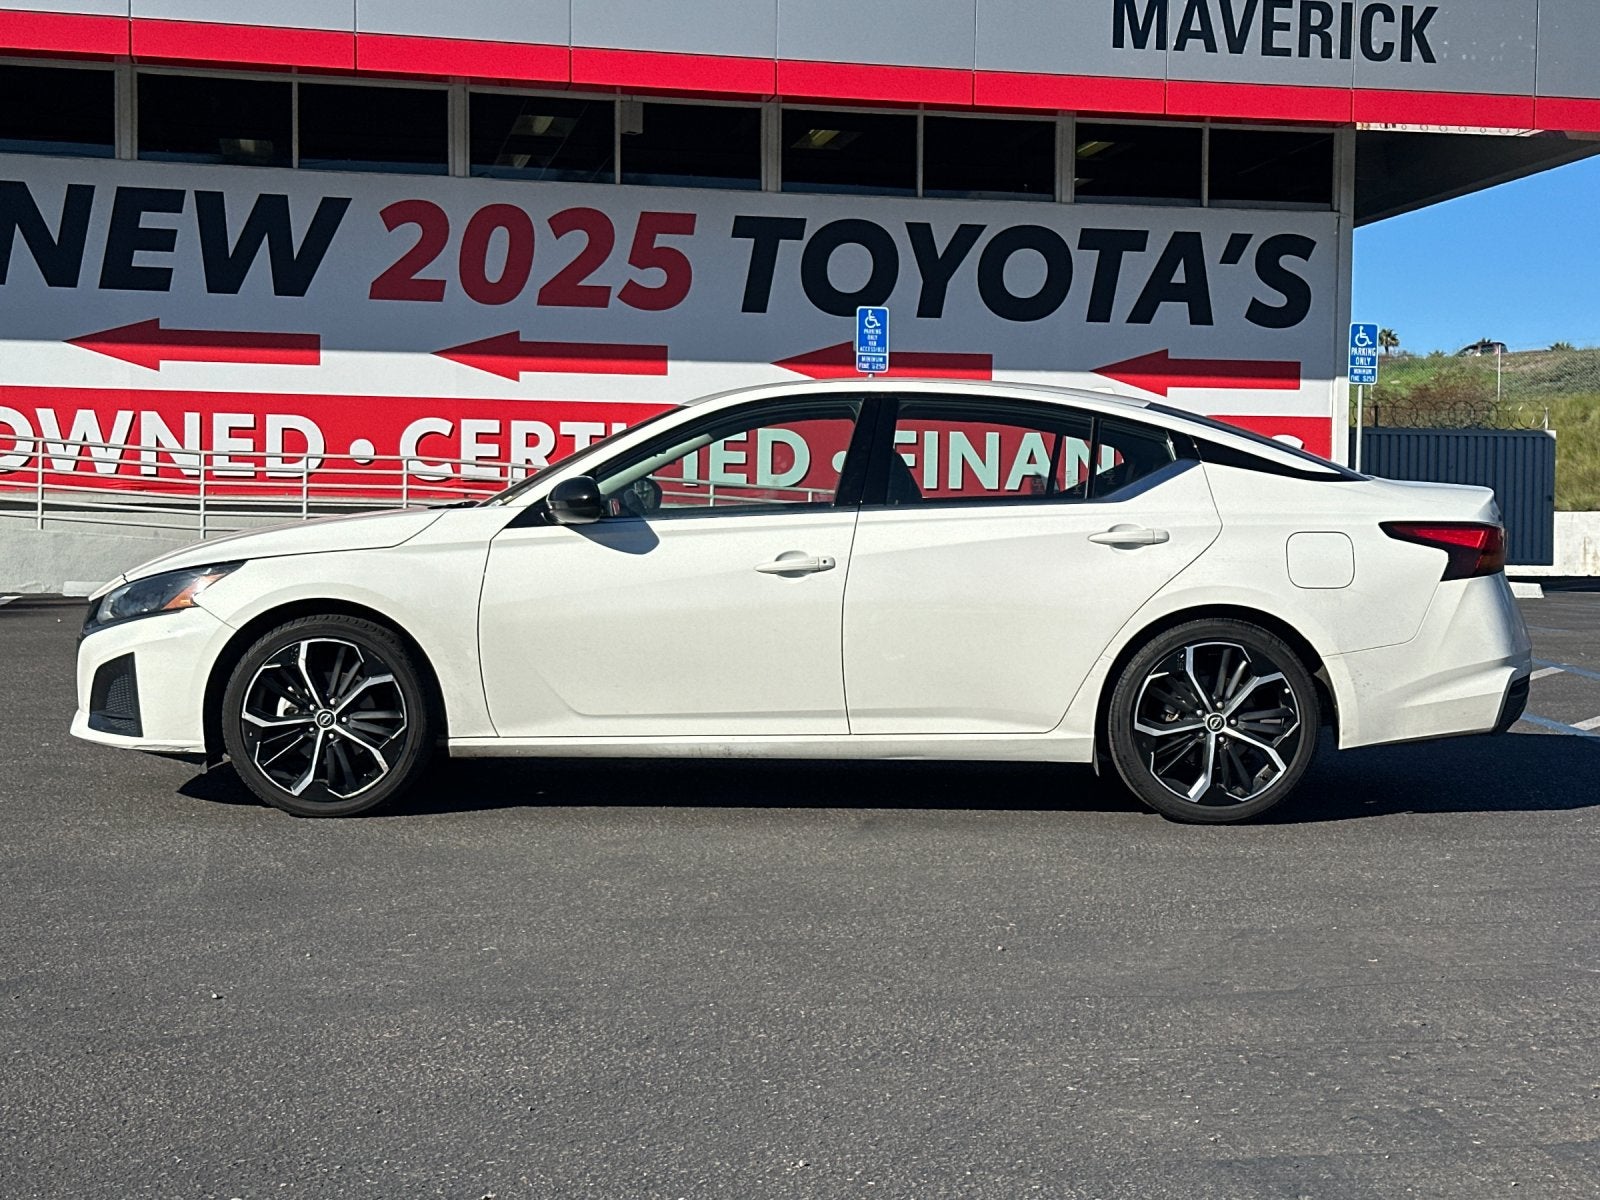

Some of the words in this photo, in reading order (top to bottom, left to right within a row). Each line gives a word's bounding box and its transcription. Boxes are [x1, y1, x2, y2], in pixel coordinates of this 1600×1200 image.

[1112, 0, 1438, 63] MAVERICK
[0, 180, 352, 297] NEW
[369, 199, 697, 311] 2025
[731, 215, 1317, 329] TOYOTA'S
[1350, 347, 1376, 357] PARKING
[1356, 357, 1371, 365] ONLY
[400, 417, 810, 487] CERTIED
